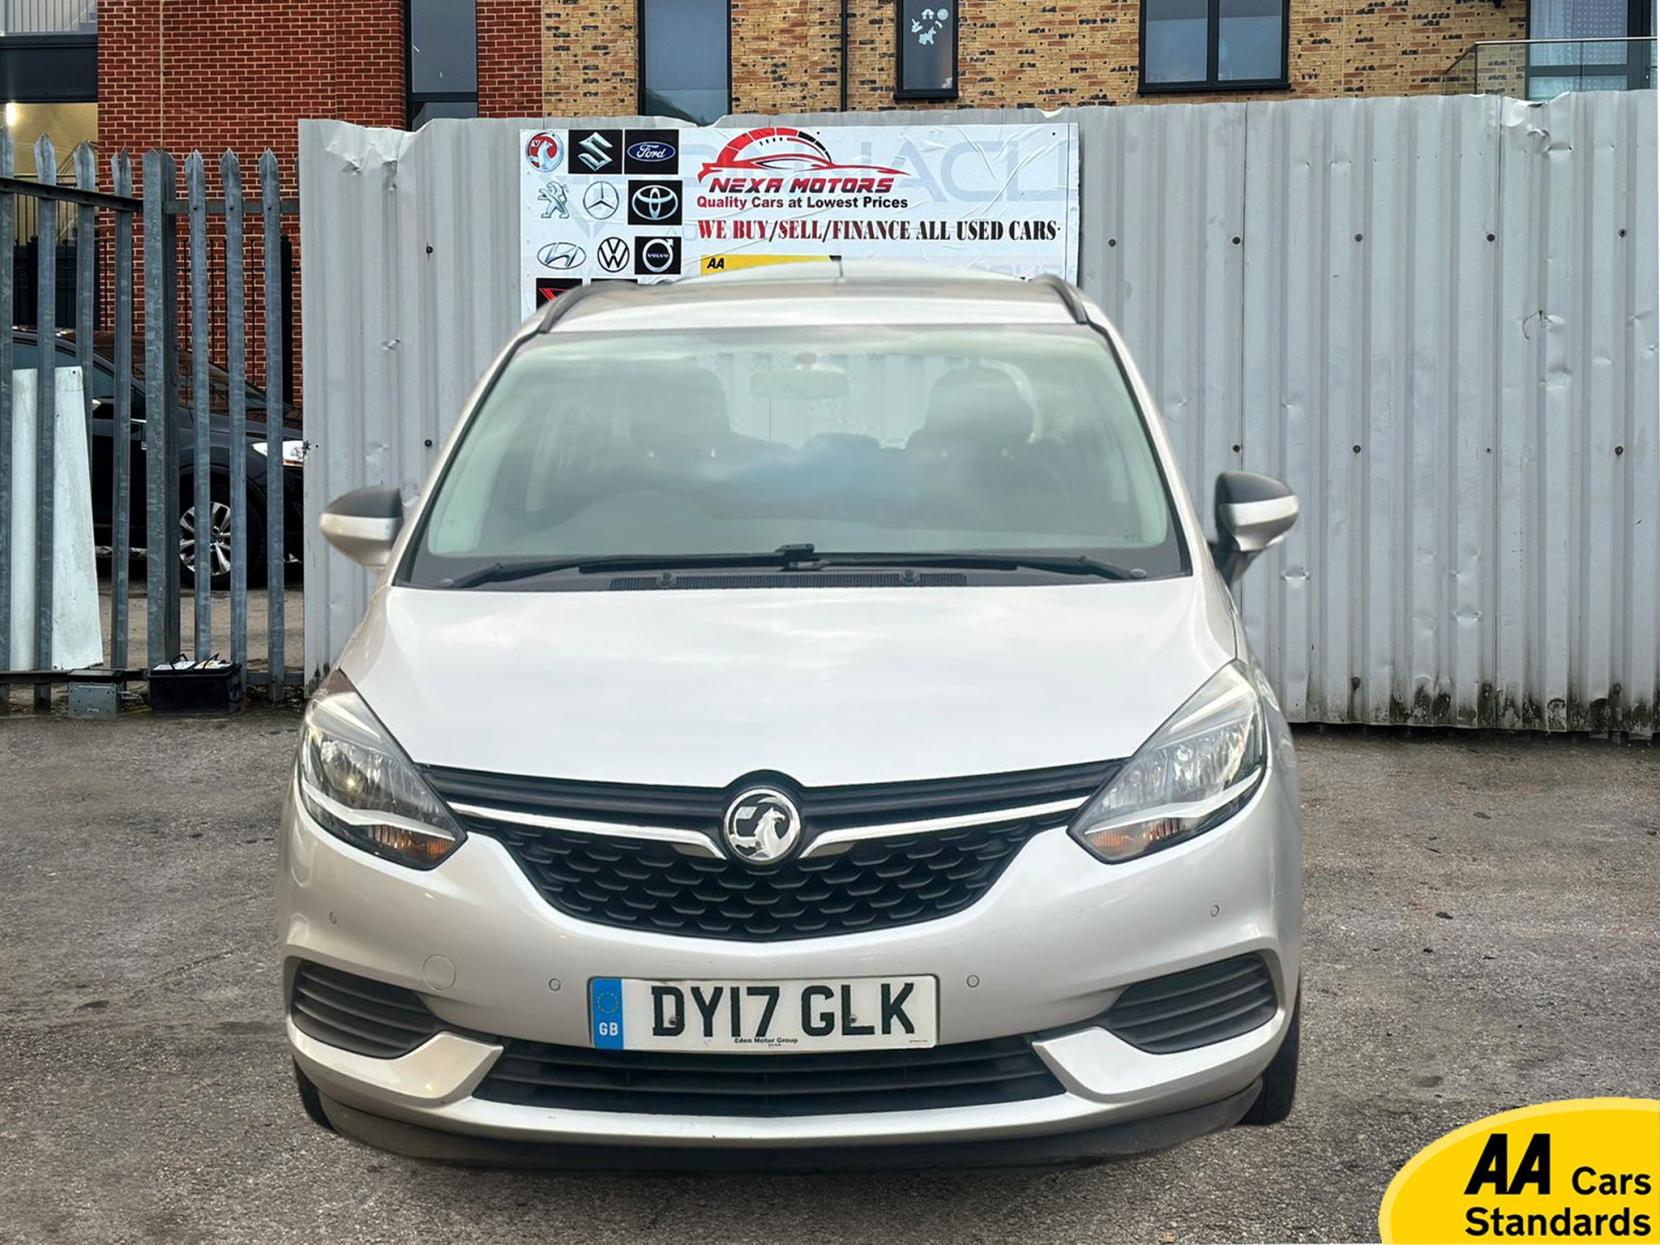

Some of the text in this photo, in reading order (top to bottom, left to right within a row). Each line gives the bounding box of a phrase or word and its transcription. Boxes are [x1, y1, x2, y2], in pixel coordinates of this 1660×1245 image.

[636, 144, 666, 159] Ford
[709, 177, 894, 193] NEXA MOTORS
[697, 195, 908, 210] Quality Cars at Lowest Prices
[698, 220, 726, 239] WE
[732, 219, 911, 243] BUY/SELL/FINANCE
[916, 220, 950, 240] ALL
[957, 220, 1003, 240] USED
[1008, 220, 1057, 240] CARS
[707, 257, 725, 269] AA
[651, 982, 915, 1038] DY17 GLK
[599, 1022, 619, 1036] GB
